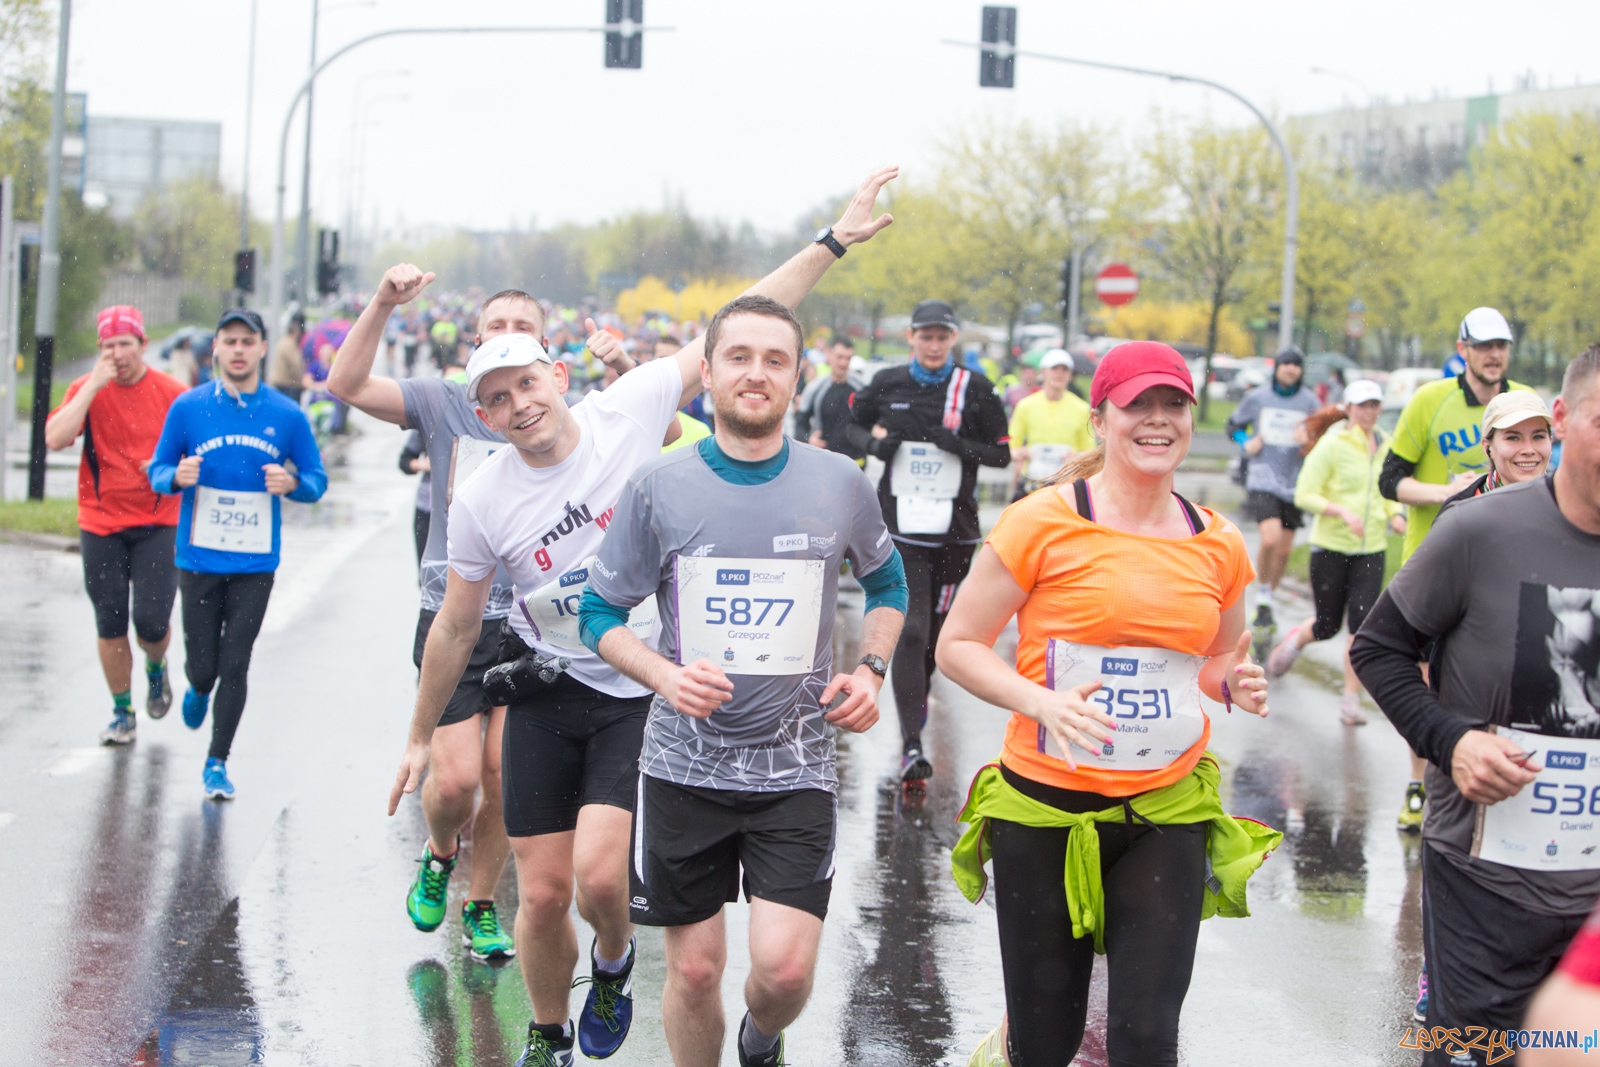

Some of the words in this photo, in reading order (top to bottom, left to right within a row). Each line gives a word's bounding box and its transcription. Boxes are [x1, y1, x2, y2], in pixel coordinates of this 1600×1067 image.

[910, 461, 942, 475] 897
[210, 509, 258, 526] 3294
[705, 596, 795, 627] 5877
[727, 630, 770, 641] Grzegorz
[1094, 686, 1172, 719] 3531
[1114, 723, 1149, 733] Marika
[1560, 821, 1594, 831] Daniel
